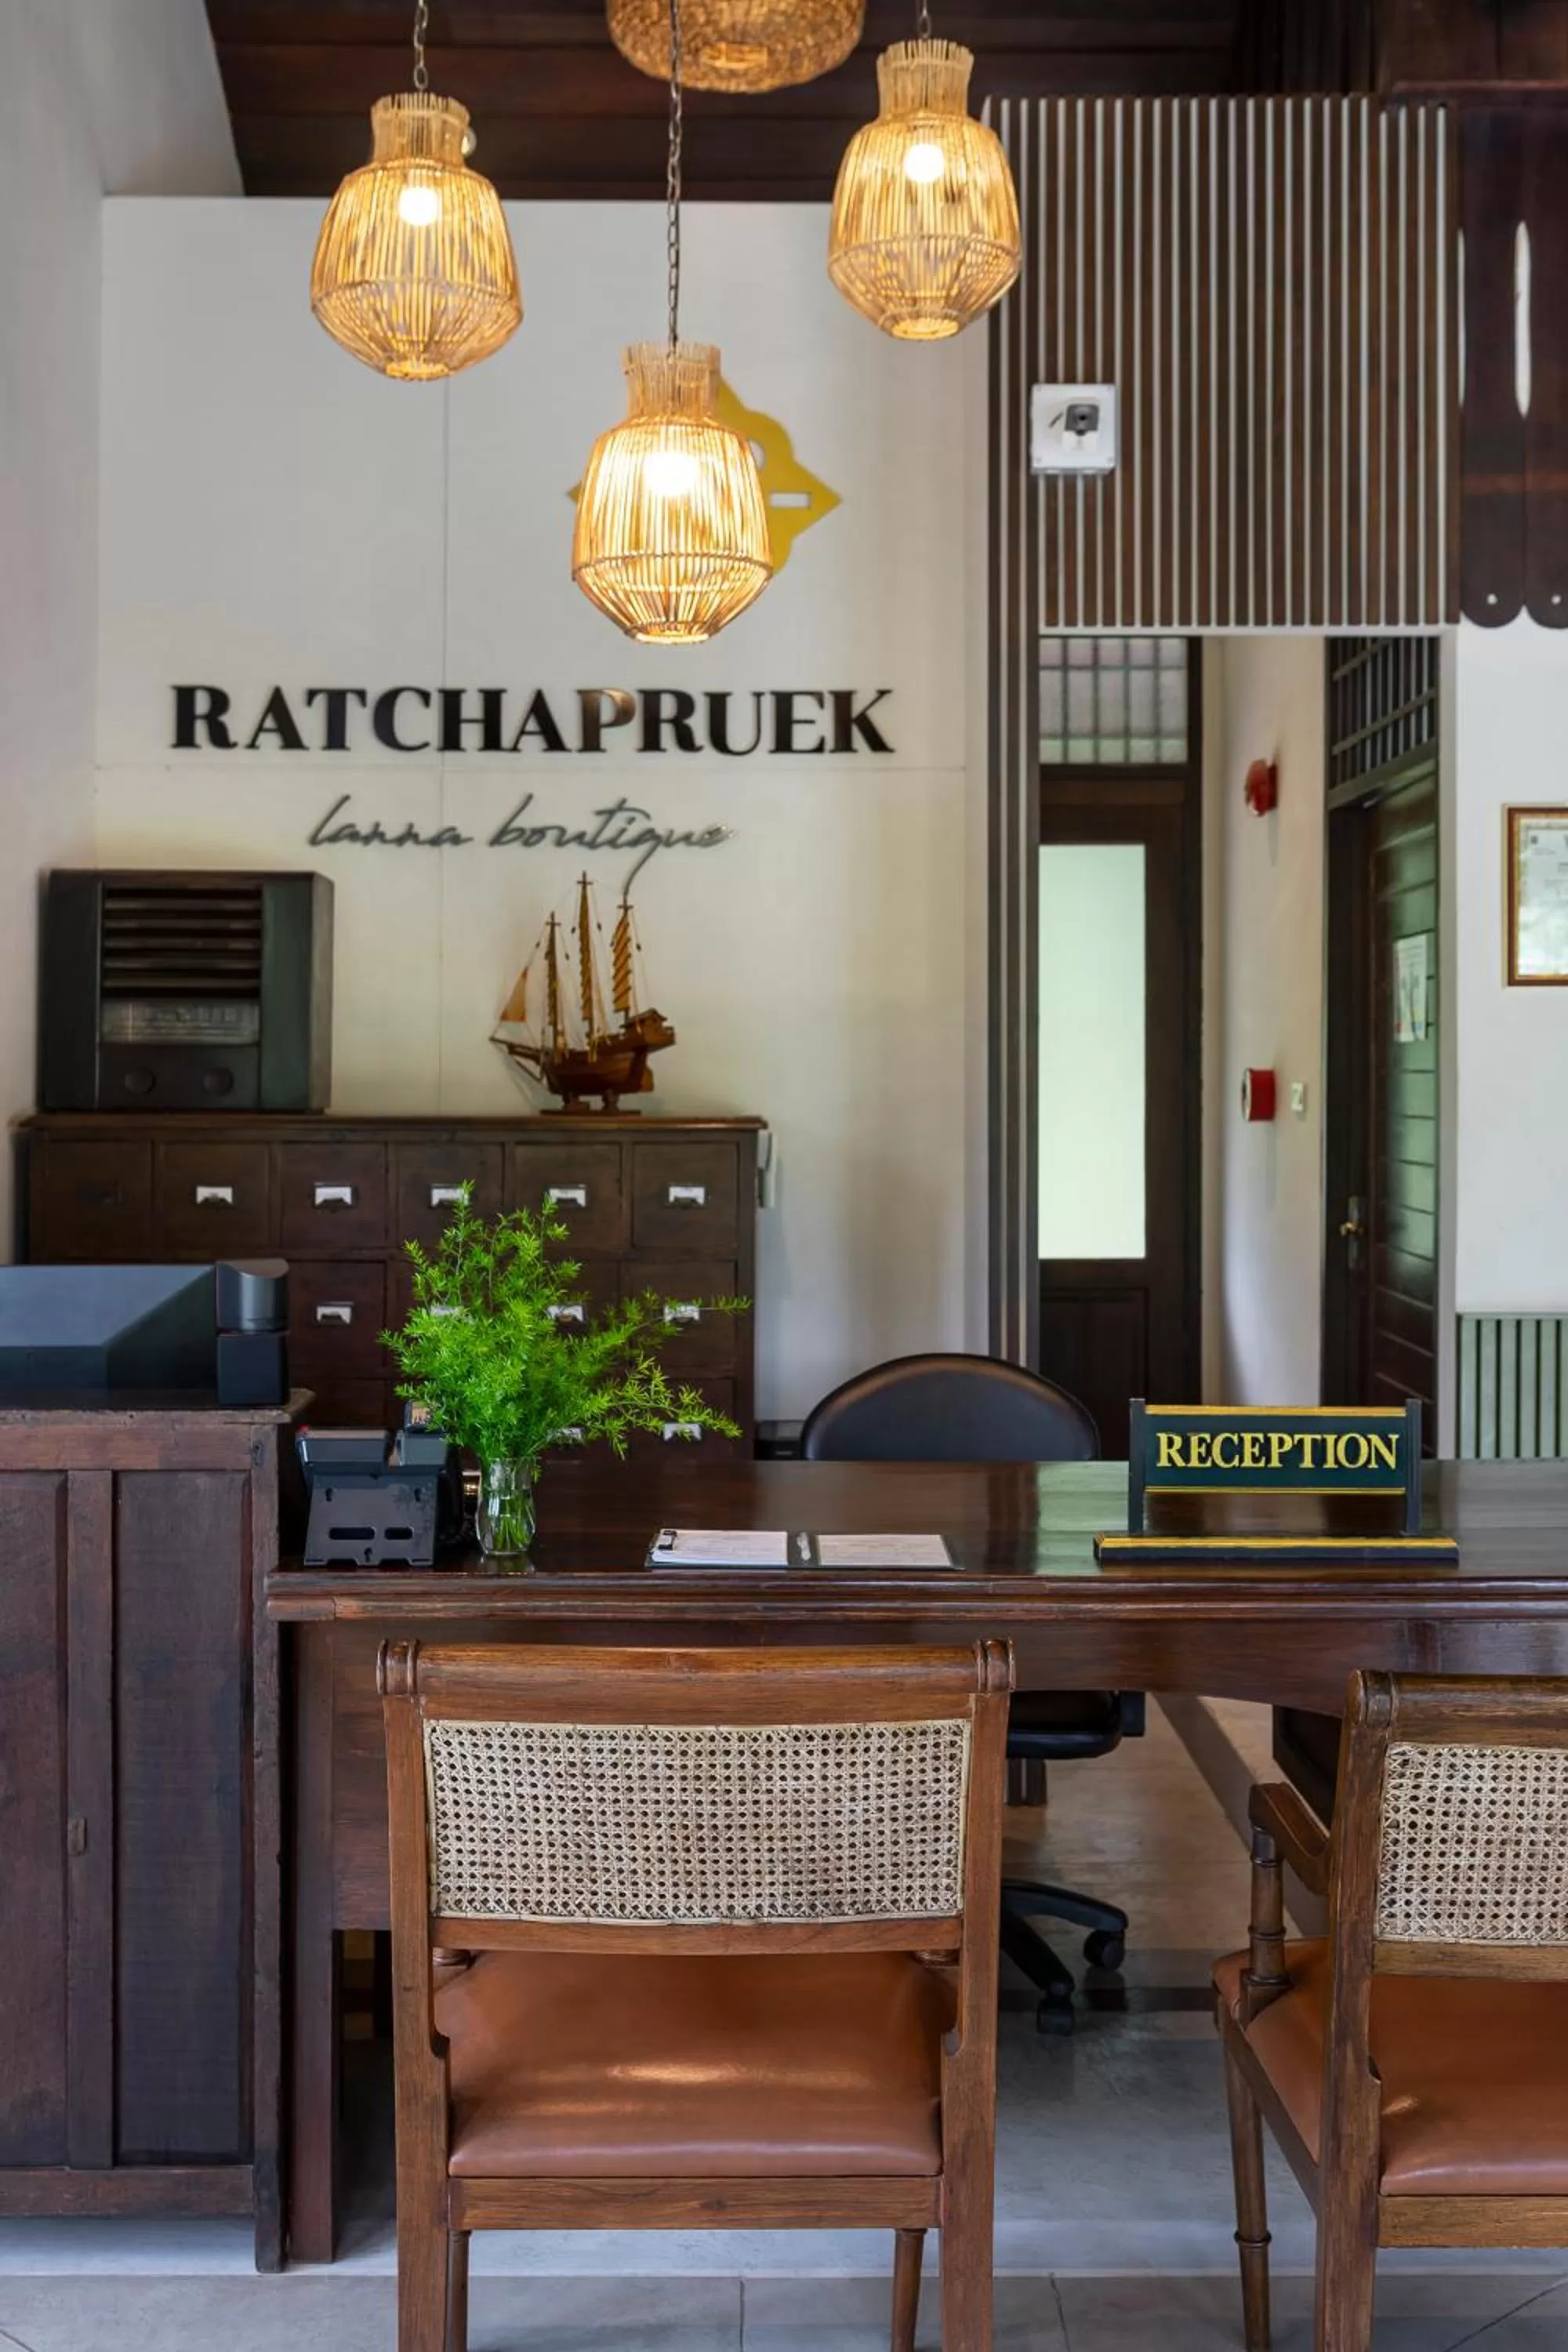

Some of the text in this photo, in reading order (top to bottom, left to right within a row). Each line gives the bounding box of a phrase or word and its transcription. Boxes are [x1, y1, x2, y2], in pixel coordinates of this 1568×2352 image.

[169, 684, 895, 755] RATCHAPRUEK
[308, 792, 733, 896] lanna boutique
[1156, 1432, 1400, 1470] RECEPTION
